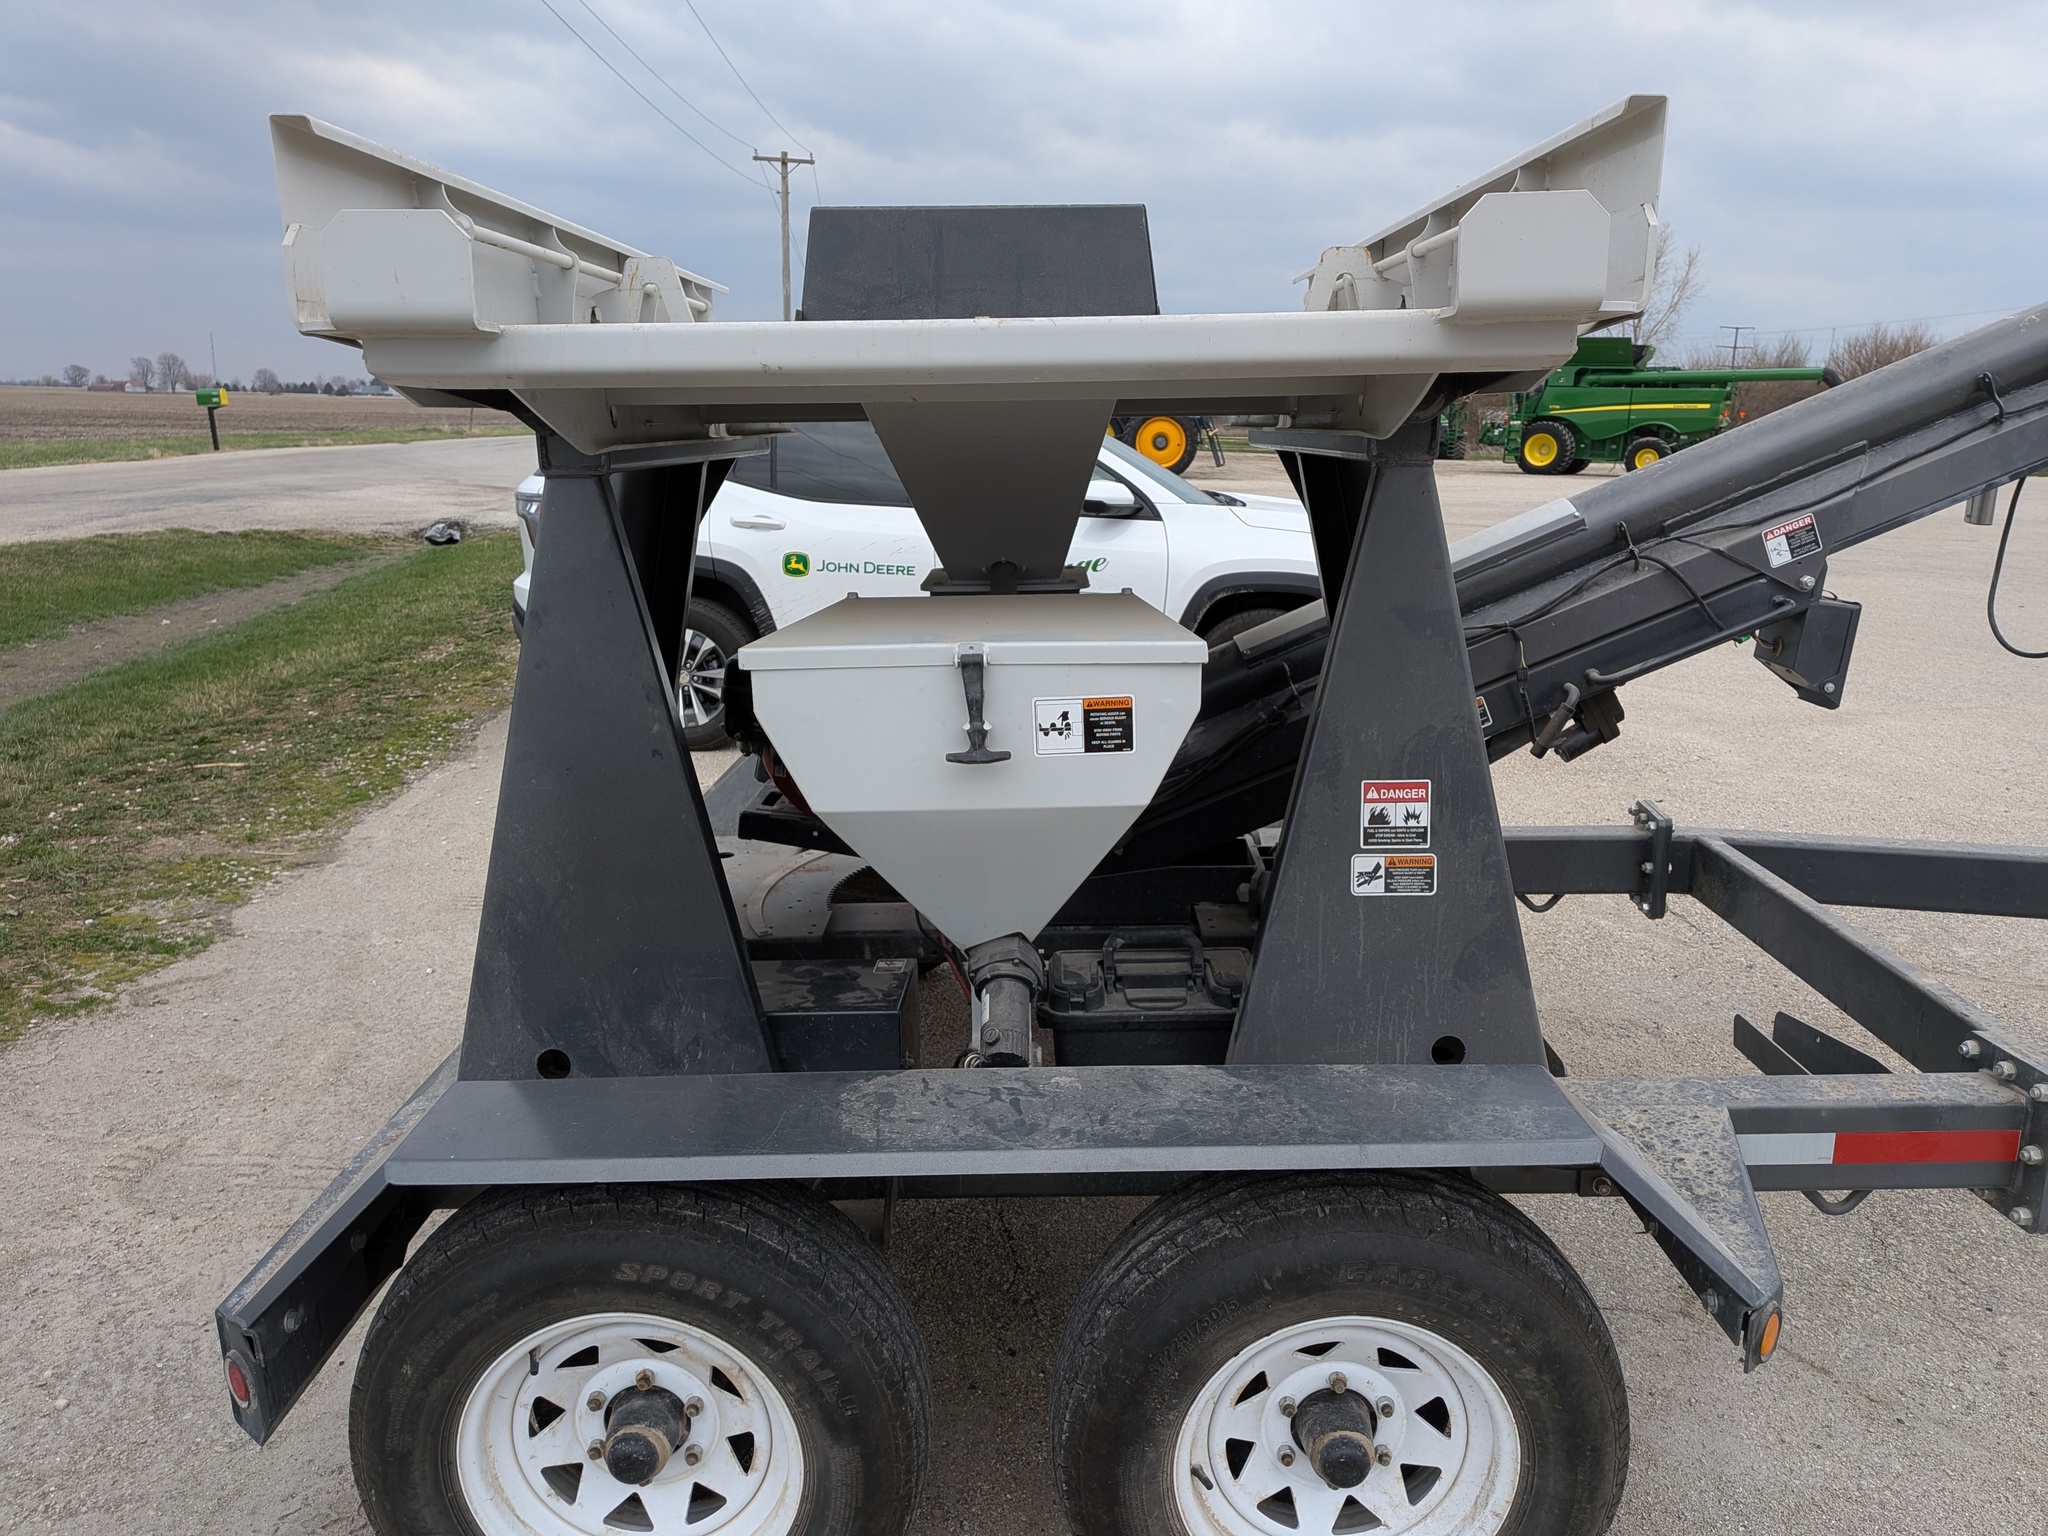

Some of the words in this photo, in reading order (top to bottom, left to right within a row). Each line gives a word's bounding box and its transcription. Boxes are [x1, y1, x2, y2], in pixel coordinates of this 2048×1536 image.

[1773, 517, 1812, 536] DANGER
[816, 560, 859, 573] JOHN
[864, 561, 916, 576] DEERE
[1380, 789, 1426, 798] DANGER
[1338, 1260, 1555, 1358] CARLISLE
[615, 1261, 751, 1310] SPORT
[756, 1310, 845, 1404] TRAIL
